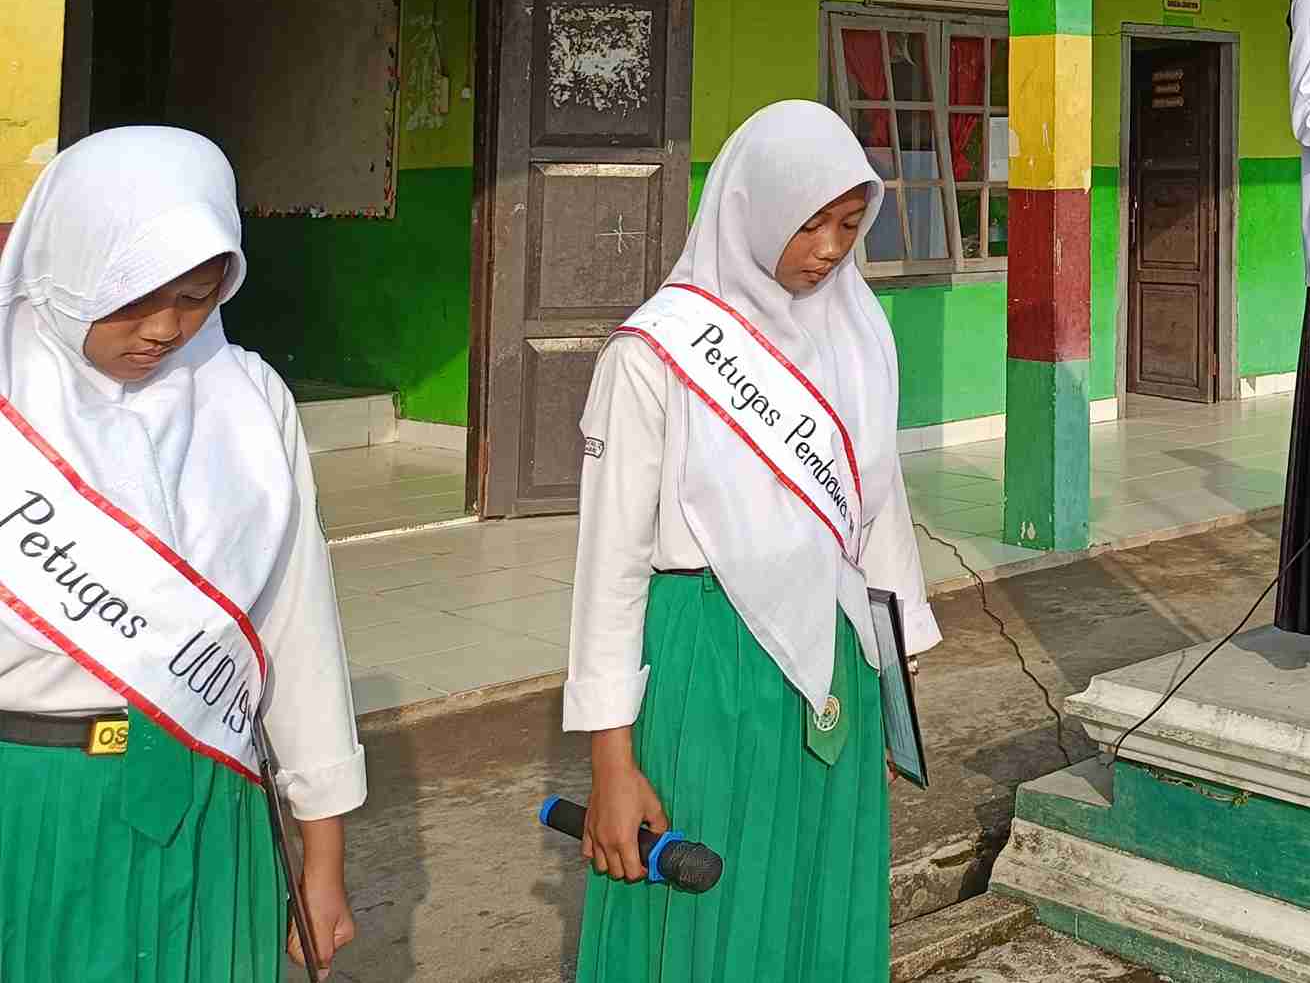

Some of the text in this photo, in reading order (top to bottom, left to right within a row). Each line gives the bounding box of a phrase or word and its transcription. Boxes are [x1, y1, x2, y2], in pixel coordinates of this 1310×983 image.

[691, 322, 848, 521] Petugas Pembawa
[0, 489, 147, 640] Petugas
[168, 629, 235, 706] UUD
